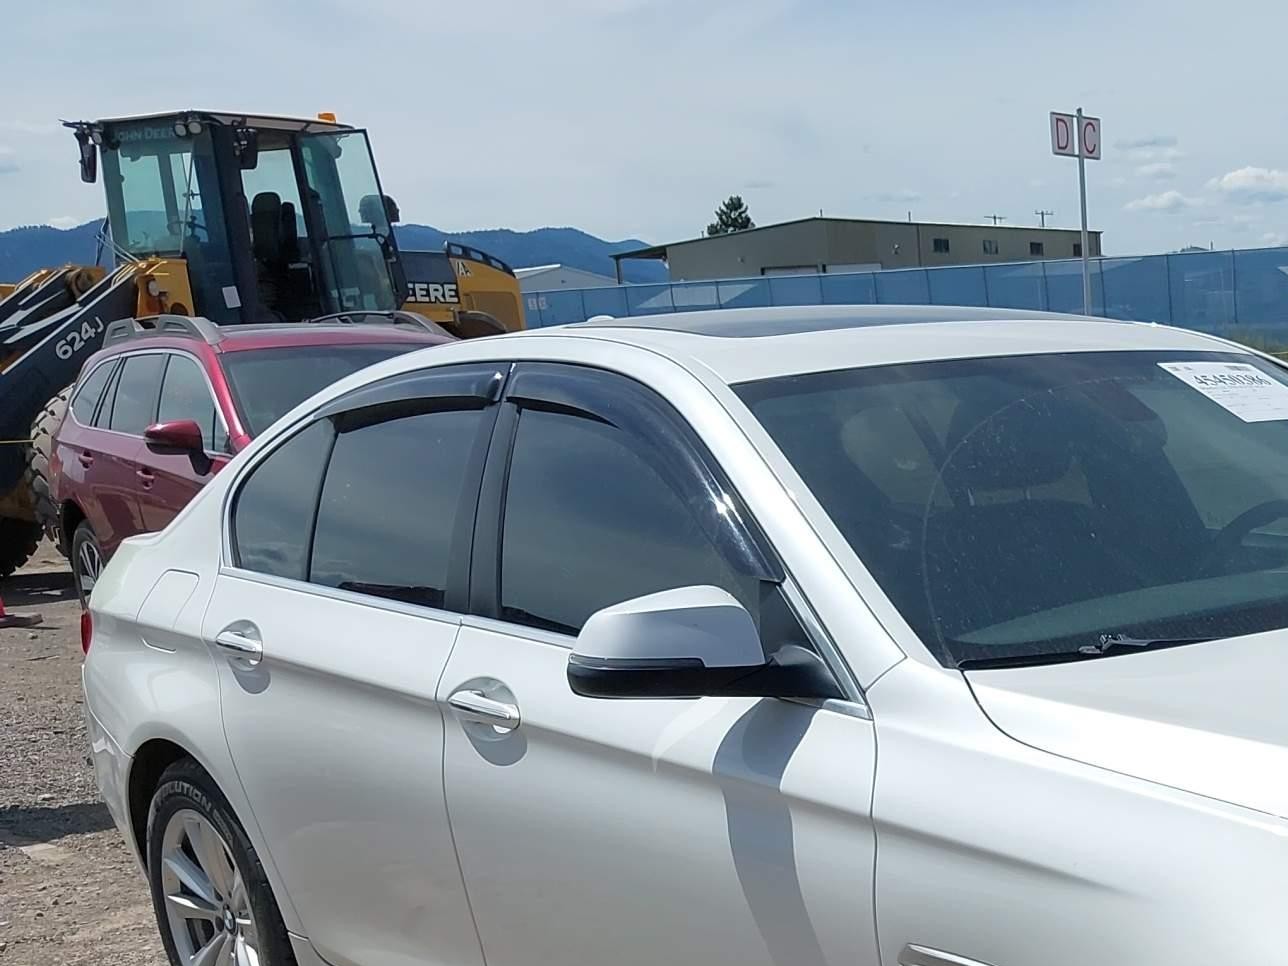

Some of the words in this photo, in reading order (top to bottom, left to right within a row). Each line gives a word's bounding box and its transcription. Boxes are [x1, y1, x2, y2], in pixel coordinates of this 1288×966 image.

[144, 127, 177, 140] DEER
[1056, 118, 1069, 150] D
[1084, 122, 1096, 154] C
[405, 283, 459, 303] EERE
[55, 316, 105, 360] 624J
